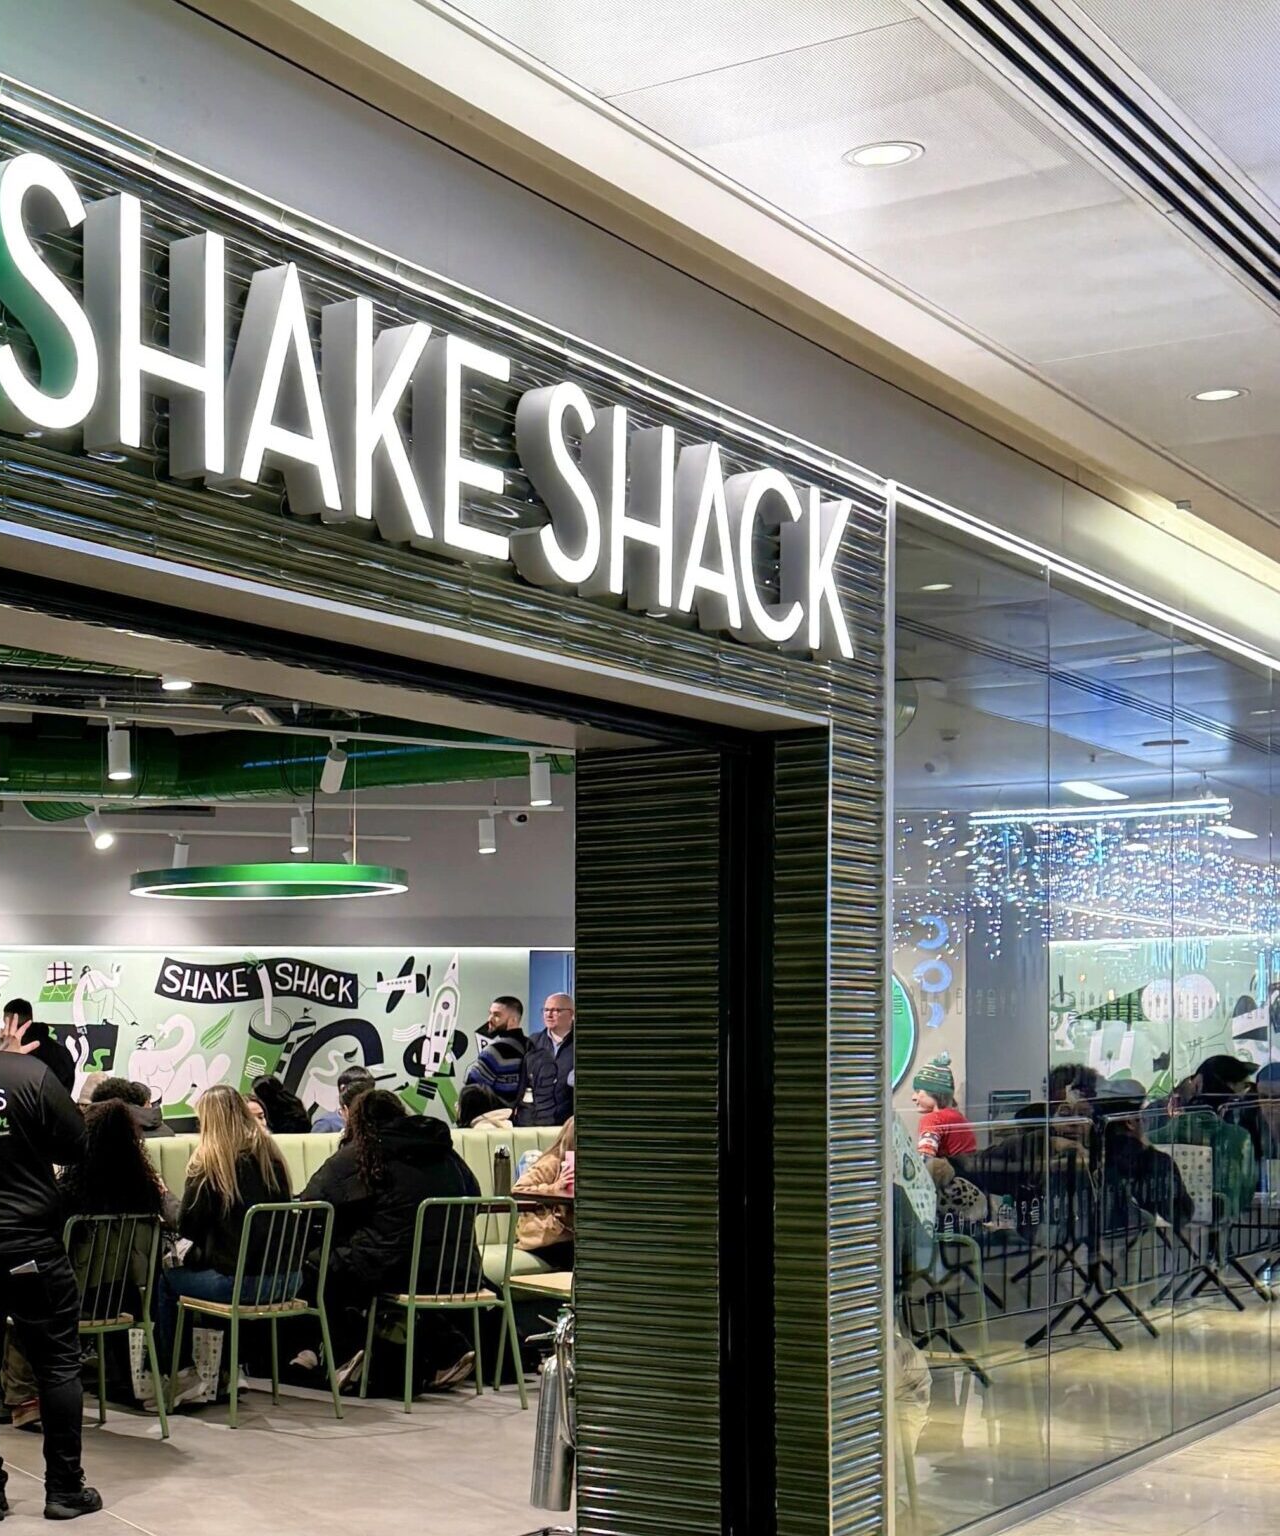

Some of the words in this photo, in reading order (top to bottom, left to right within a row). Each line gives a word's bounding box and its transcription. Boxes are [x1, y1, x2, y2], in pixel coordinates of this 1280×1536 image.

[538, 382, 855, 660] SHACK
[161, 964, 250, 1000] SHAKE
[274, 962, 354, 1003] SHACK
